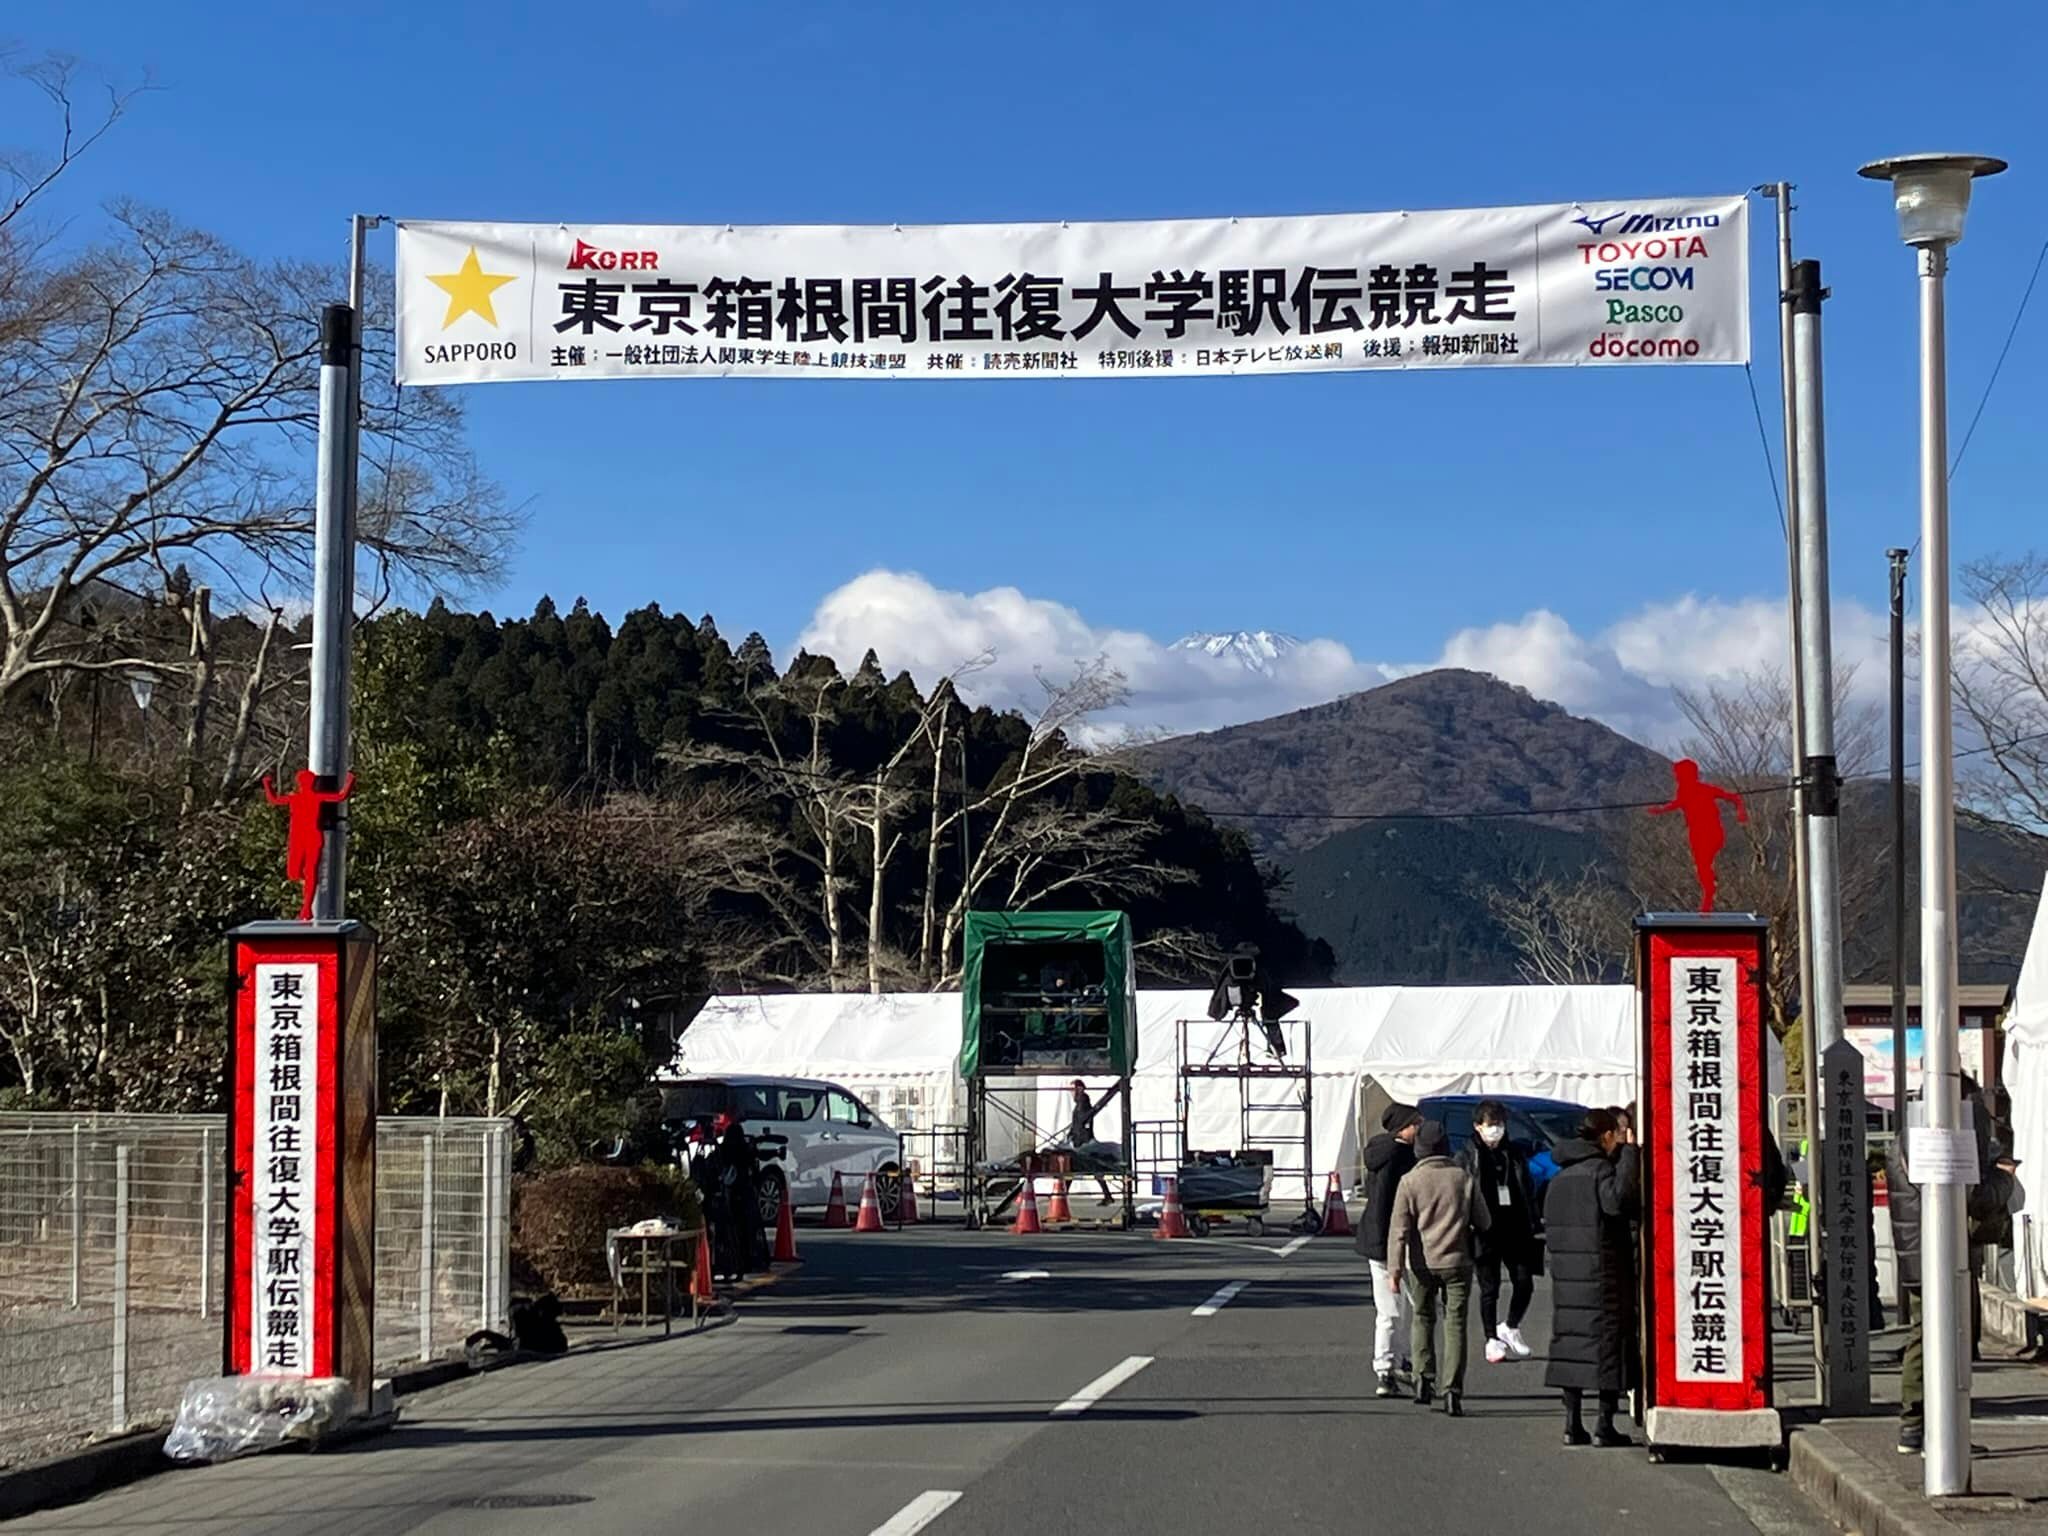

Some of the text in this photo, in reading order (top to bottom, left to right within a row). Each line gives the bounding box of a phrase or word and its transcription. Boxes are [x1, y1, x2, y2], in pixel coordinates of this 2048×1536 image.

[1577, 236, 1708, 264] TOYOTA
[1595, 266, 1694, 292] SECOM
[553, 260, 1517, 343] 東京箱根間往復大学駅伝競走
[1606, 299, 1683, 325] Pasco
[425, 342, 517, 364] SAPPORO
[1589, 332, 1700, 358] docomo
[266, 972, 303, 1368] 東京箱根間往復大学駅伝競走
[1686, 966, 1727, 1374] 東京箱根間往復大学駅伝競走
